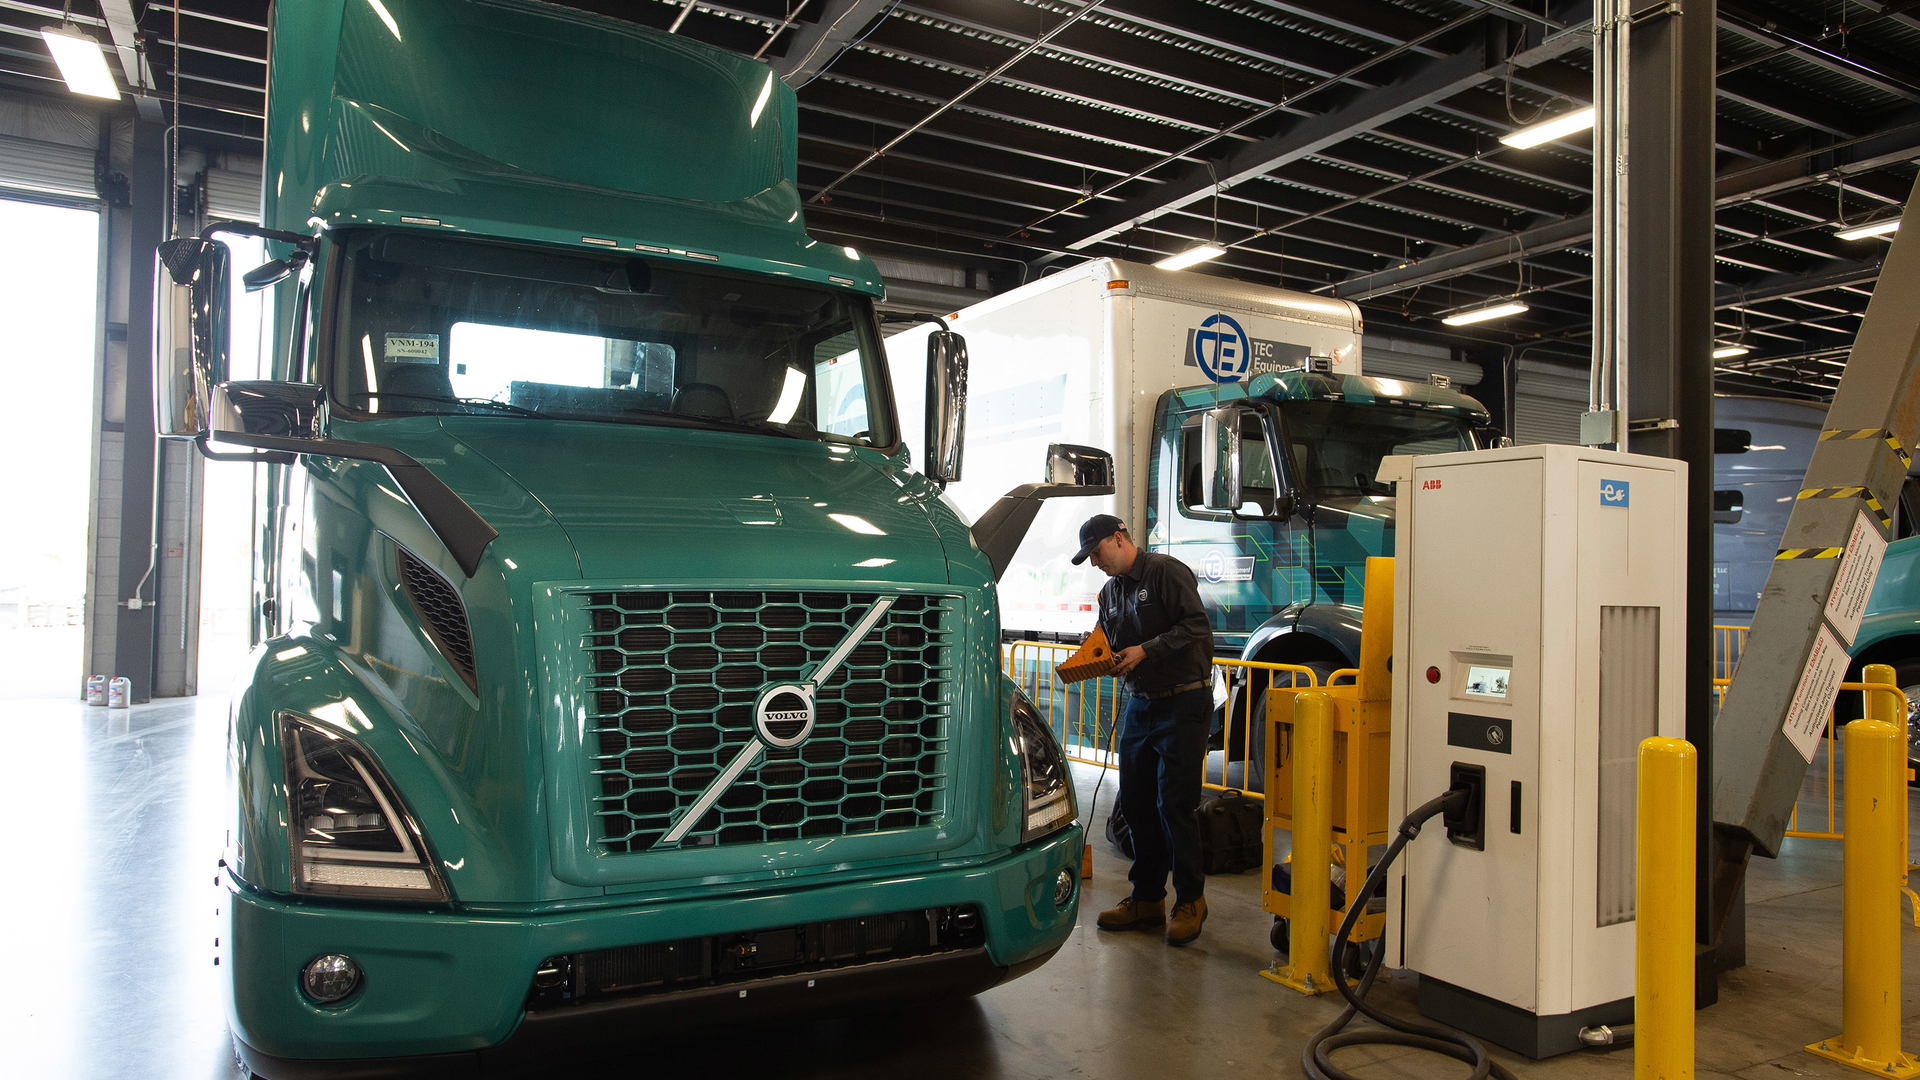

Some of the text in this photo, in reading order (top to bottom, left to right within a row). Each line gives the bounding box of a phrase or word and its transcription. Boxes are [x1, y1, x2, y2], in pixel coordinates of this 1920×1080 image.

[390, 339, 435, 348] VNM-194
[1254, 341, 1273, 357] TEC
[1254, 356, 1304, 374] Equipm
[1422, 479, 1442, 491] ABB
[1837, 559, 1849, 587] Function
[1849, 522, 1862, 554] ENABLED
[1849, 588, 1862, 621] Authorized
[1864, 555, 1874, 578] Trained
[1856, 583, 1868, 613] Personnel
[1796, 674, 1809, 703] Function
[1810, 635, 1824, 668] ENABLED
[764, 711, 808, 720] VOLVO
[1808, 703, 1823, 737] Authorized
[1825, 670, 1836, 693] Trained
[1816, 685, 1835, 730] Personnel Only
